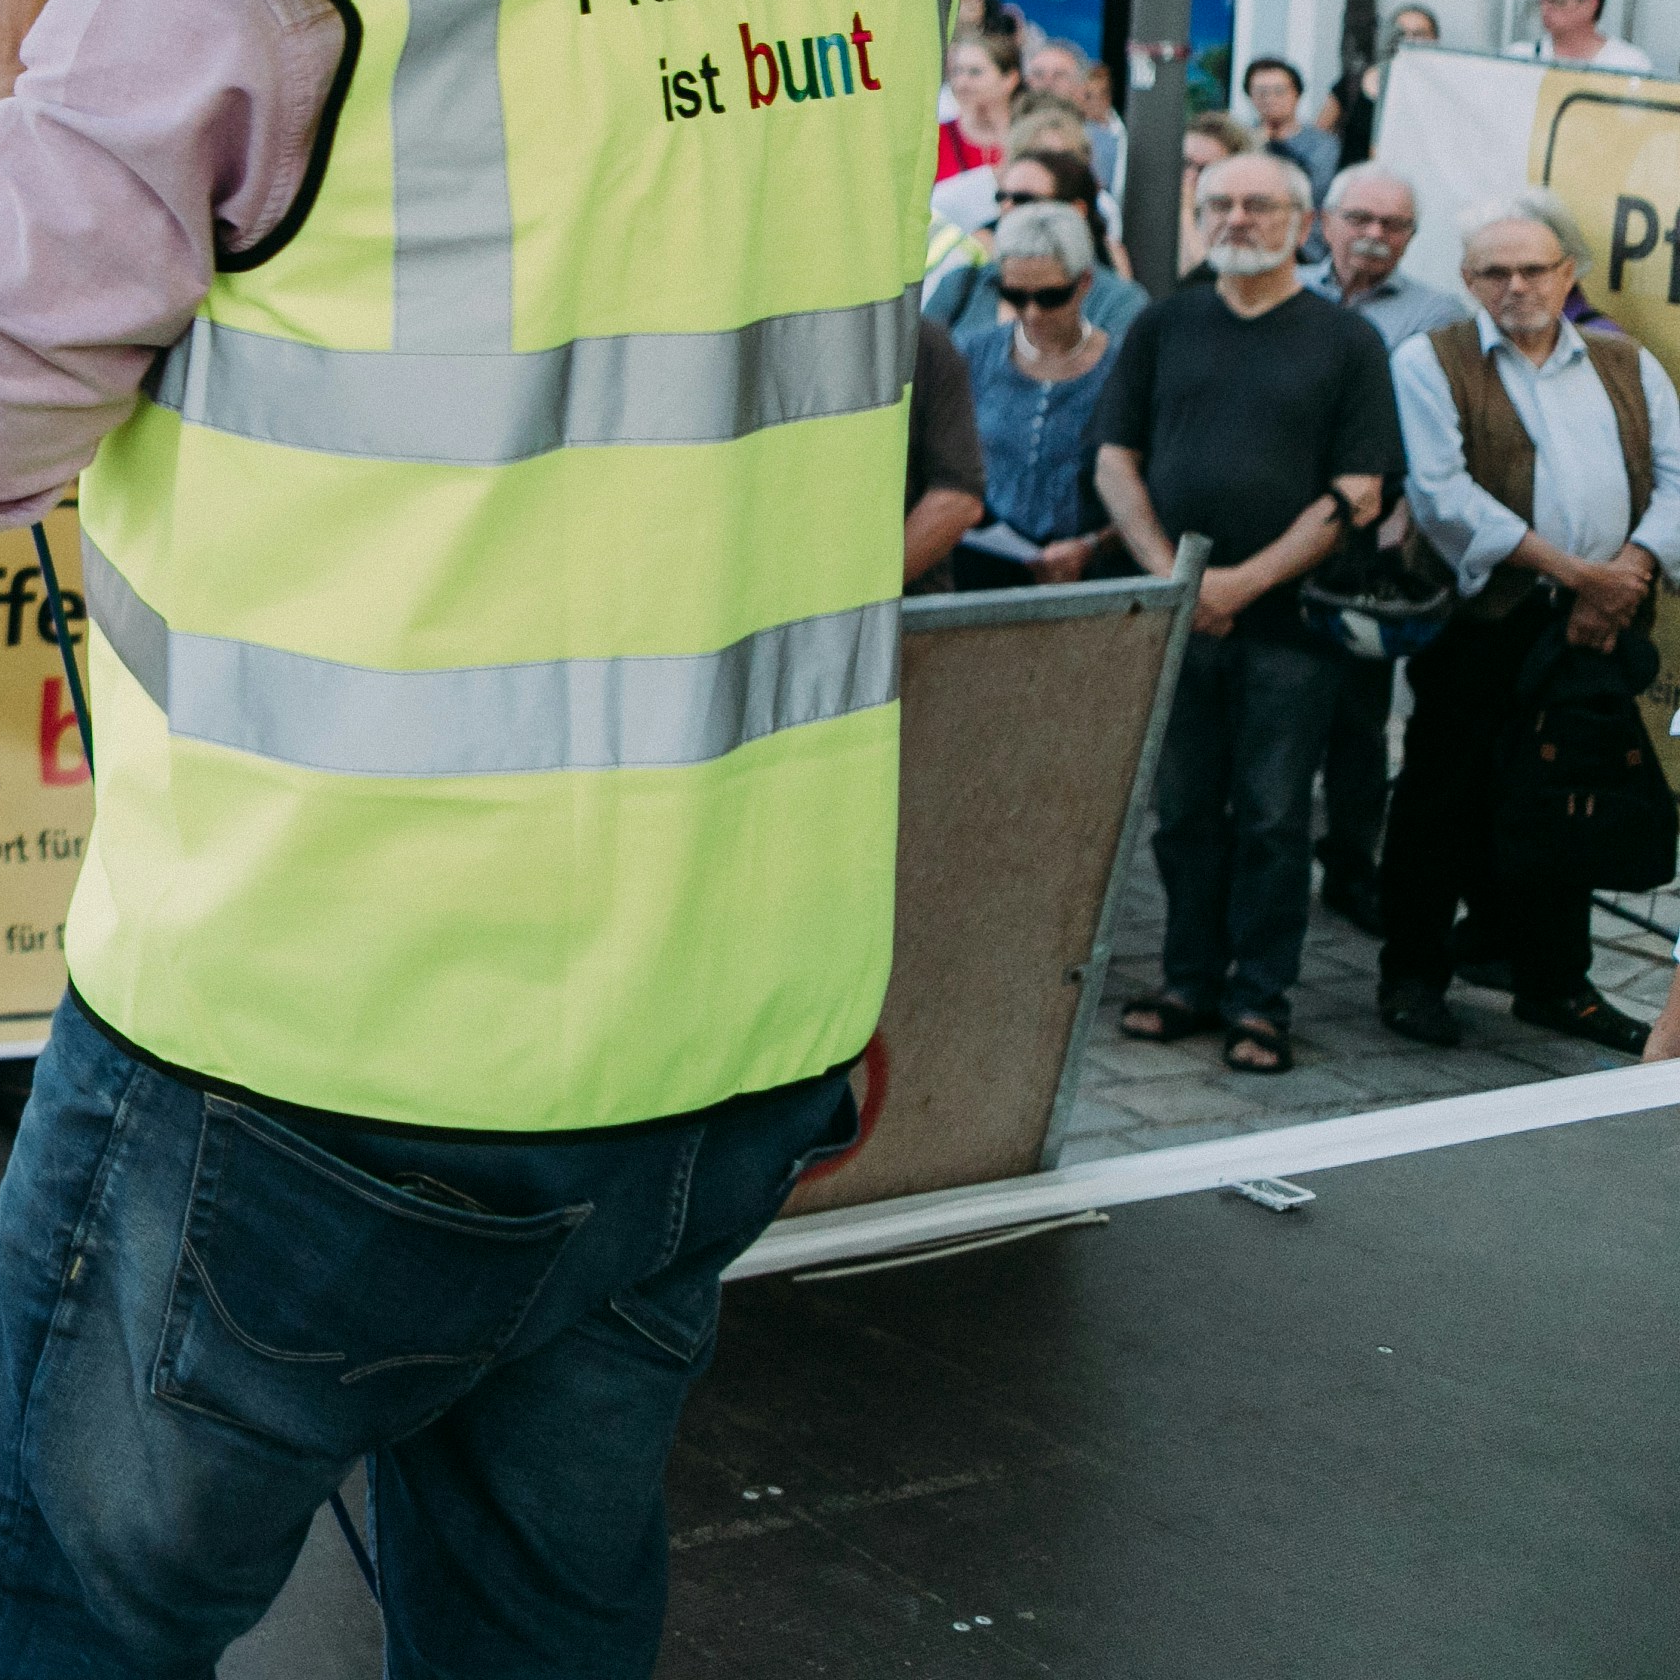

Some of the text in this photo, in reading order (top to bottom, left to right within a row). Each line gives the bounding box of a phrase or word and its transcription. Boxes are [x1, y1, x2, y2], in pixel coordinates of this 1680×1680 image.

[658, 11, 882, 122] ist bunt
[37, 827, 85, 862] für
[6, 922, 51, 956] für
